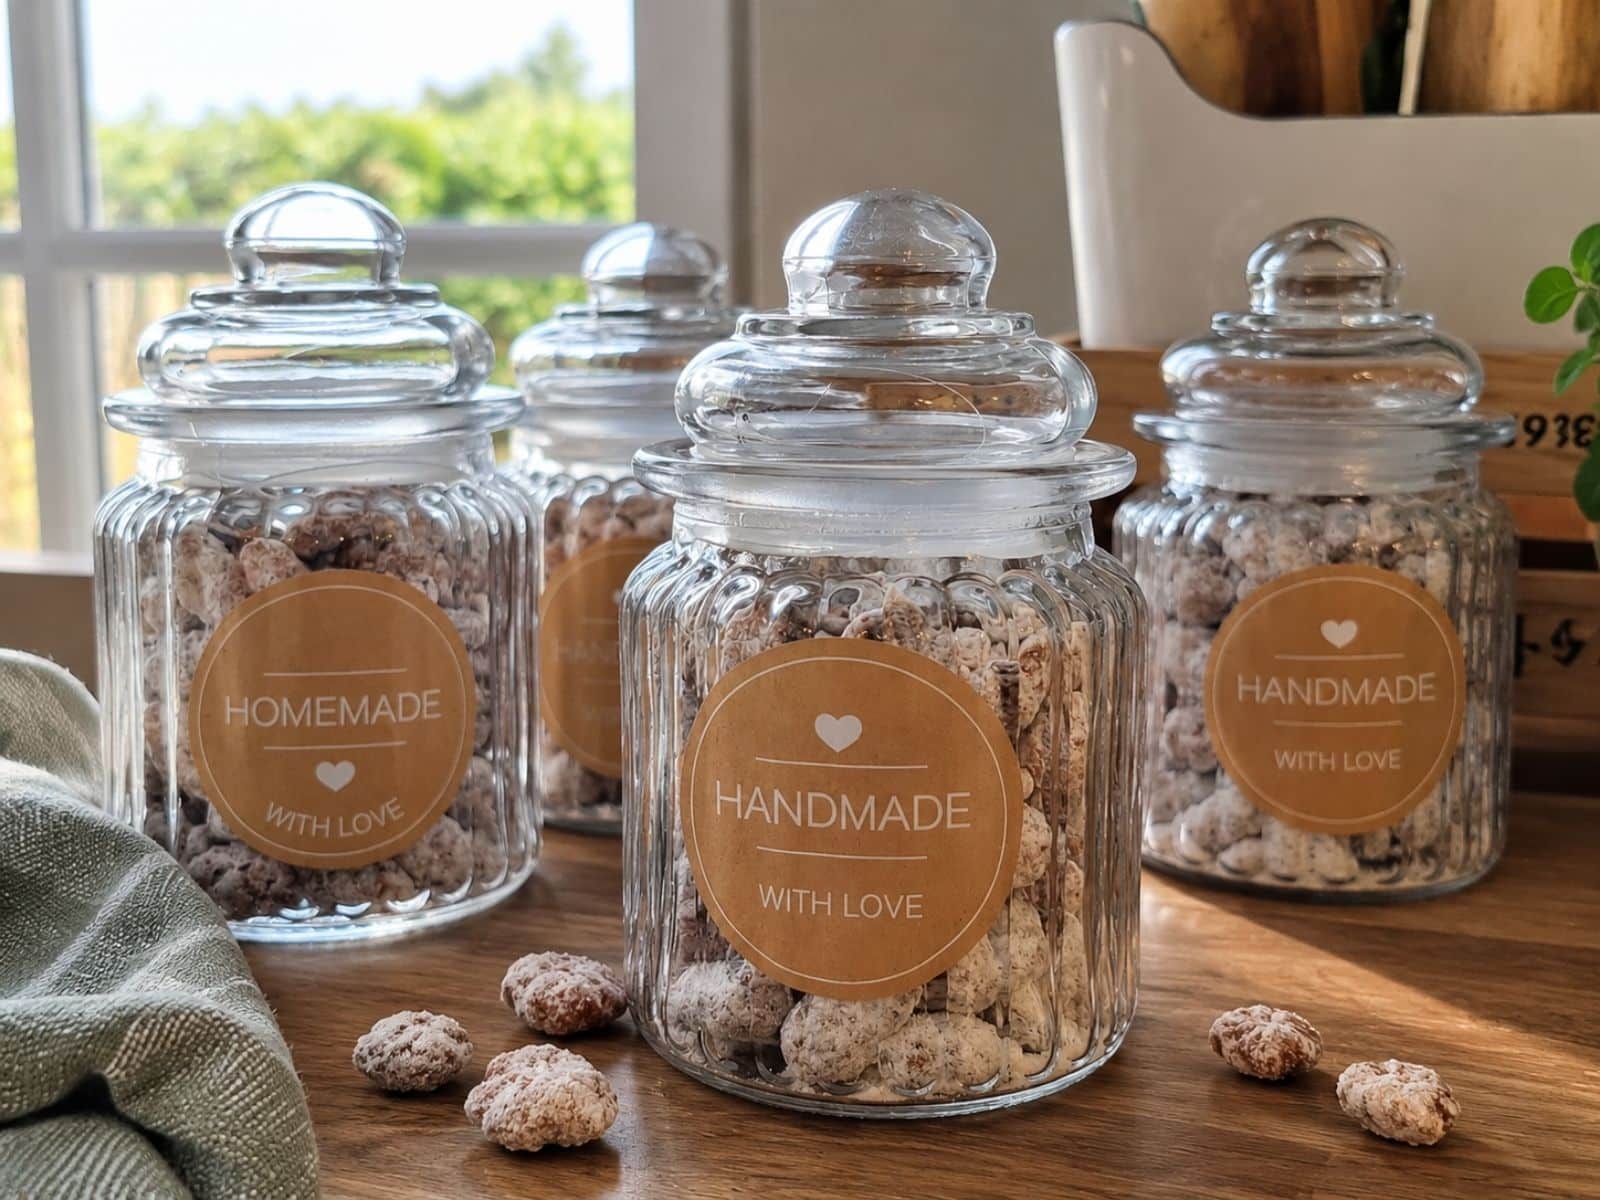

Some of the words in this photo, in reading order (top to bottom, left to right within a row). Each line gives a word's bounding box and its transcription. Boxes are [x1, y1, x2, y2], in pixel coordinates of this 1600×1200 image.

[224, 688, 442, 727] HOMEMADE
[1236, 671, 1436, 706] HANDMADE
[1273, 750, 1336, 772] WITH
[1343, 749, 1402, 772] LOVE
[265, 800, 331, 838] WITH
[338, 796, 405, 837] LOVE
[715, 779, 972, 832] HANDMADE
[758, 883, 833, 917] WITH
[842, 892, 925, 920] LOVE
